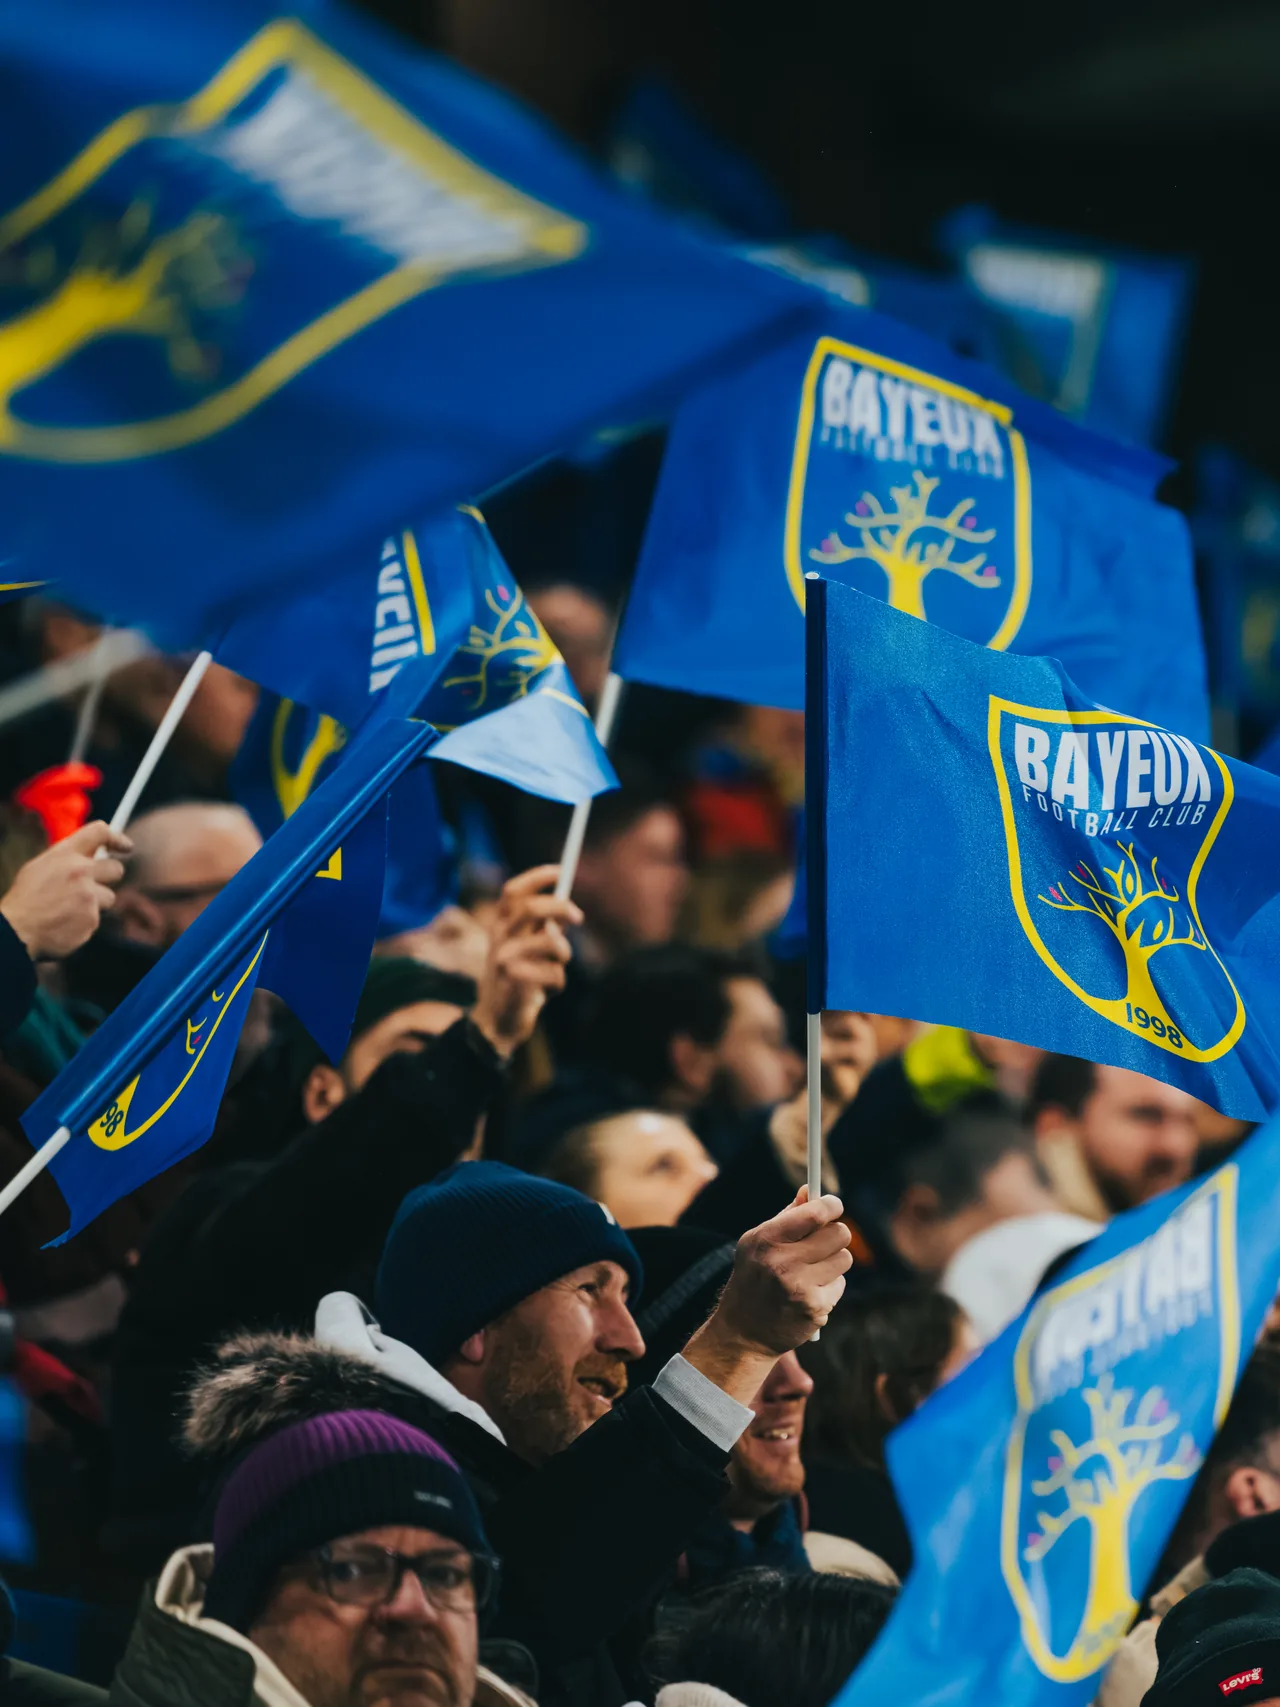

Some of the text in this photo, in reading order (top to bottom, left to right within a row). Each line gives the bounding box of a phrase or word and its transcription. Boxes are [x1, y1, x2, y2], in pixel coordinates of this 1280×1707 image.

[822, 357, 1003, 457] BAYEUX
[1014, 722, 1212, 811] BAYEUX
[1022, 784, 1207, 838] FOOTBALL CLUB
[1125, 1002, 1184, 1049] 1998
[100, 1102, 124, 1138] 98
